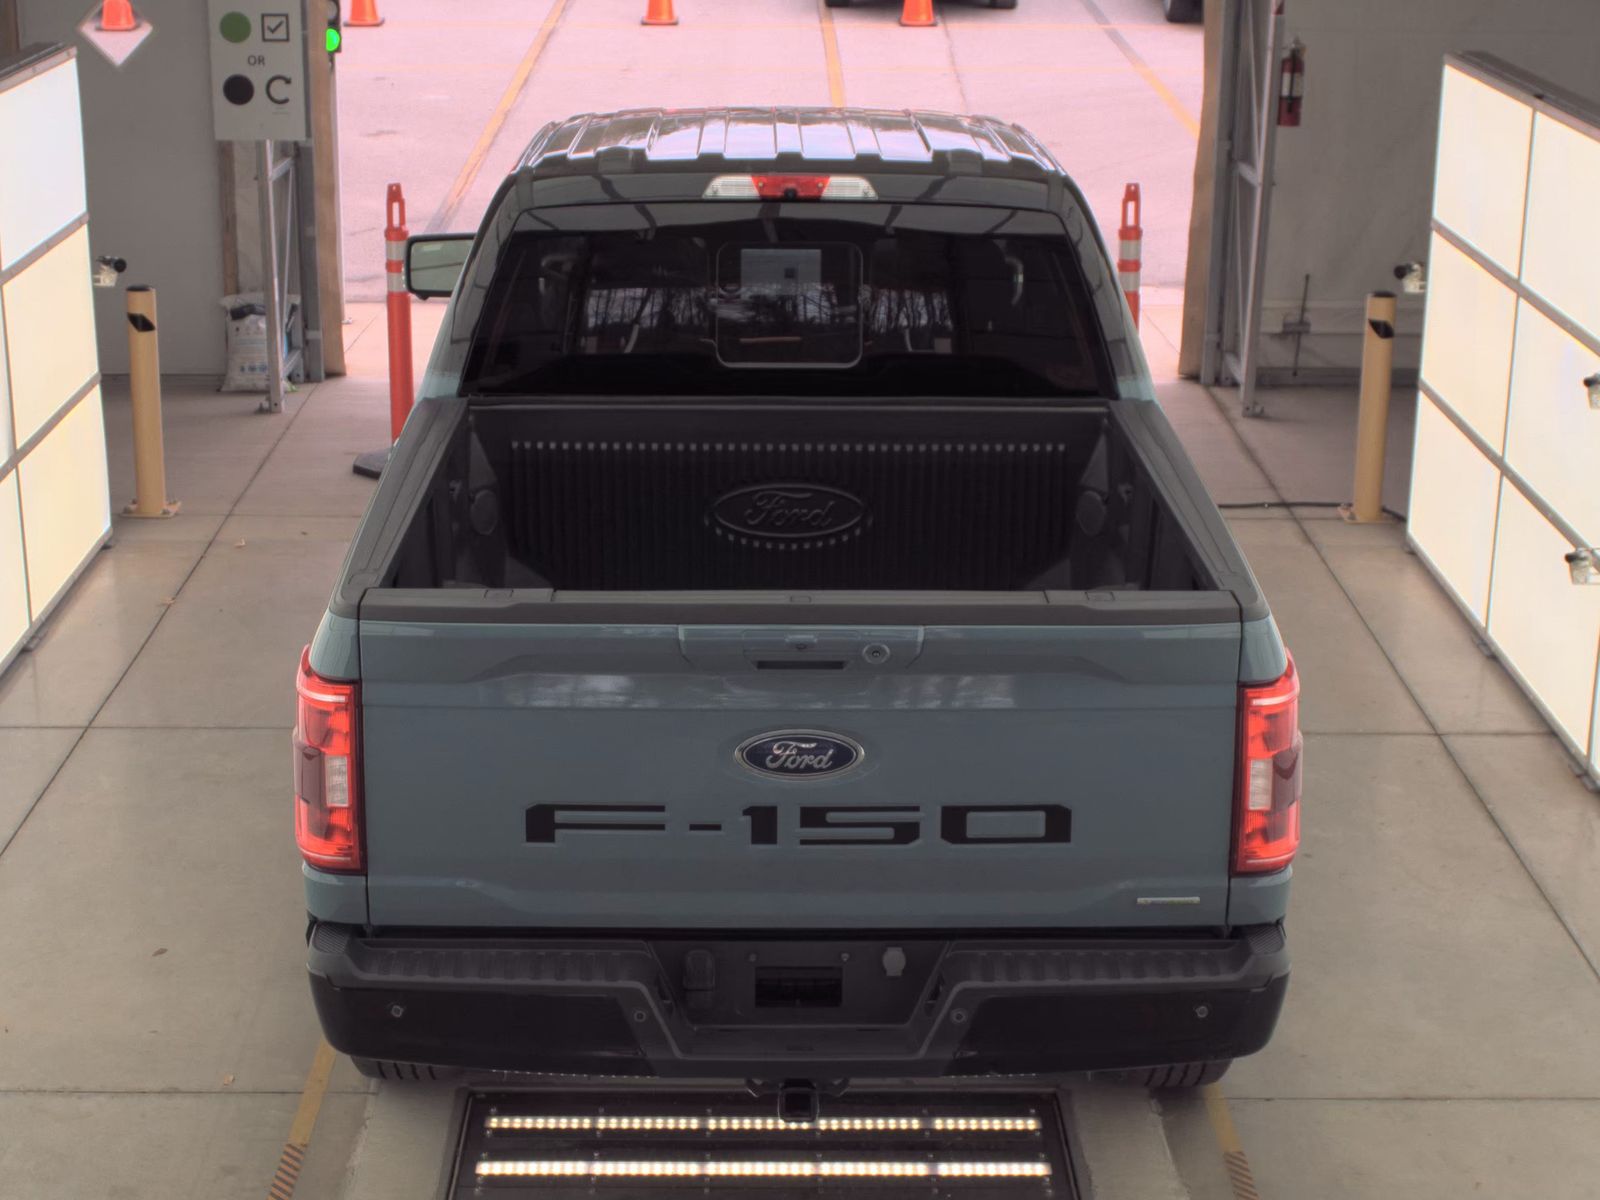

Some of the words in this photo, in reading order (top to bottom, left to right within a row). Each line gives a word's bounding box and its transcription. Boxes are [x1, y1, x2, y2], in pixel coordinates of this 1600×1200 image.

[247, 55, 266, 66] OR
[743, 491, 835, 526] Ford
[766, 741, 834, 769] Ford
[525, 803, 1072, 845] F-150
